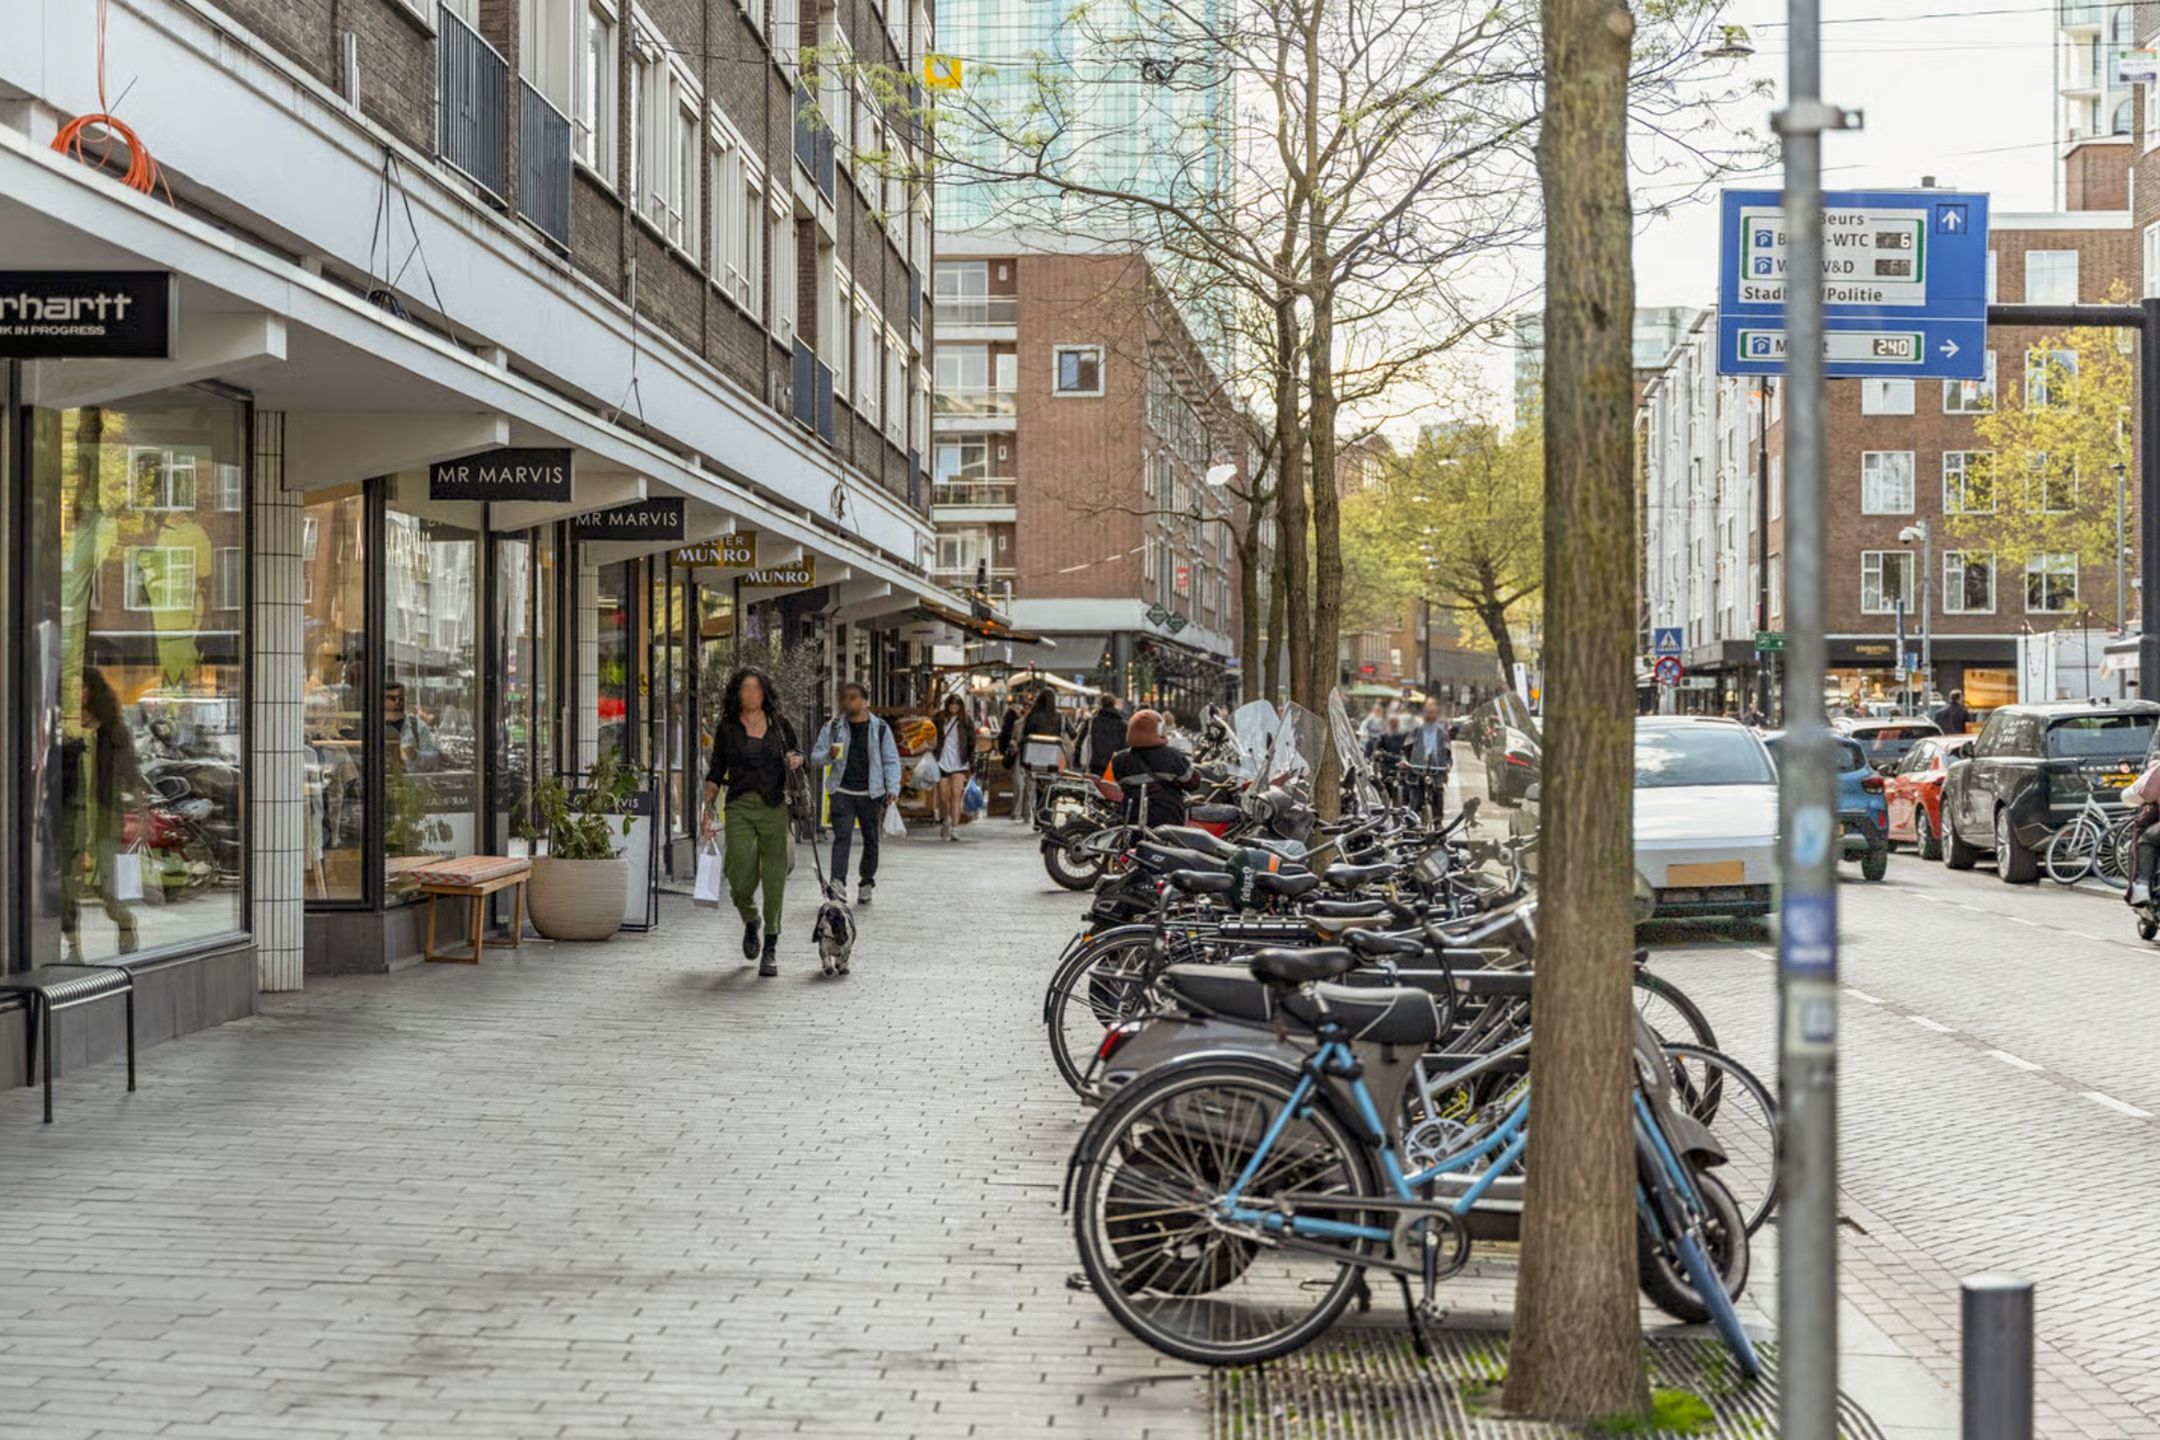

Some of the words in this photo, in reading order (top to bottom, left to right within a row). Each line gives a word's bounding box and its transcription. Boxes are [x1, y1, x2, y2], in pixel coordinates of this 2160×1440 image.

[14, 325, 29, 336] IN
[30, 325, 106, 336] PROGRESS
[1876, 339, 1909, 356] 240
[437, 466, 469, 484] MR
[478, 465, 564, 484] MARVIS
[574, 512, 602, 527] MR
[608, 511, 678, 527] MARVIS
[676, 548, 751, 563] MUNRO
[745, 571, 810, 584] MUNRO
